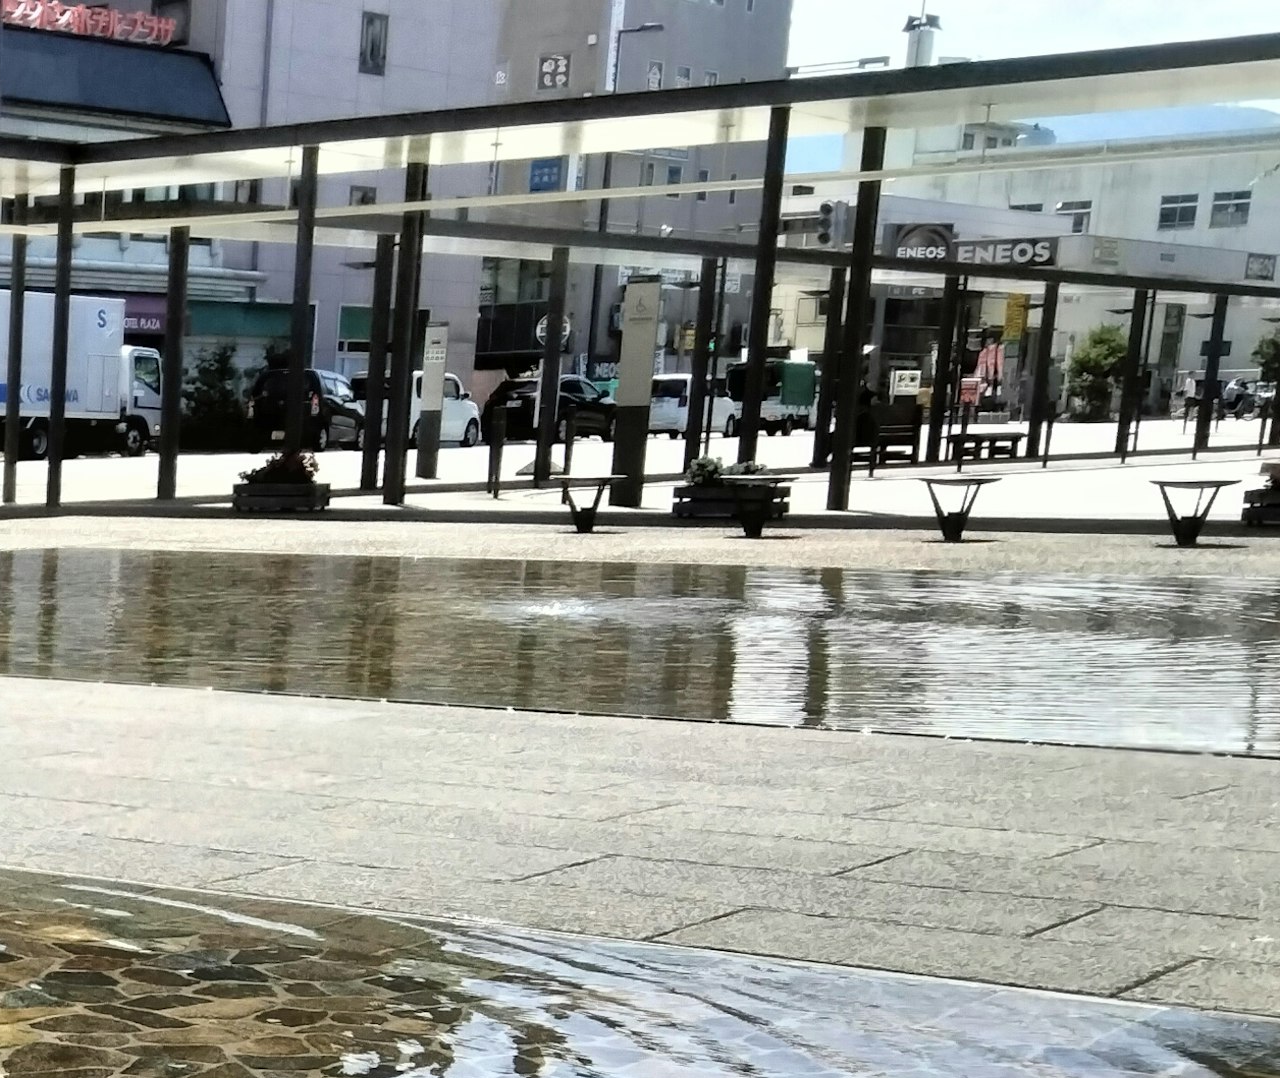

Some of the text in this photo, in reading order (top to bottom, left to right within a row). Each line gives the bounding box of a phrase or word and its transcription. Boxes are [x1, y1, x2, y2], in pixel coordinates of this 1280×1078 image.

[896, 245, 947, 260] ENEOS
[956, 241, 1052, 266] ENEOS
[140, 317, 161, 330] PLAZA
[36, 387, 79, 403] SAWA
